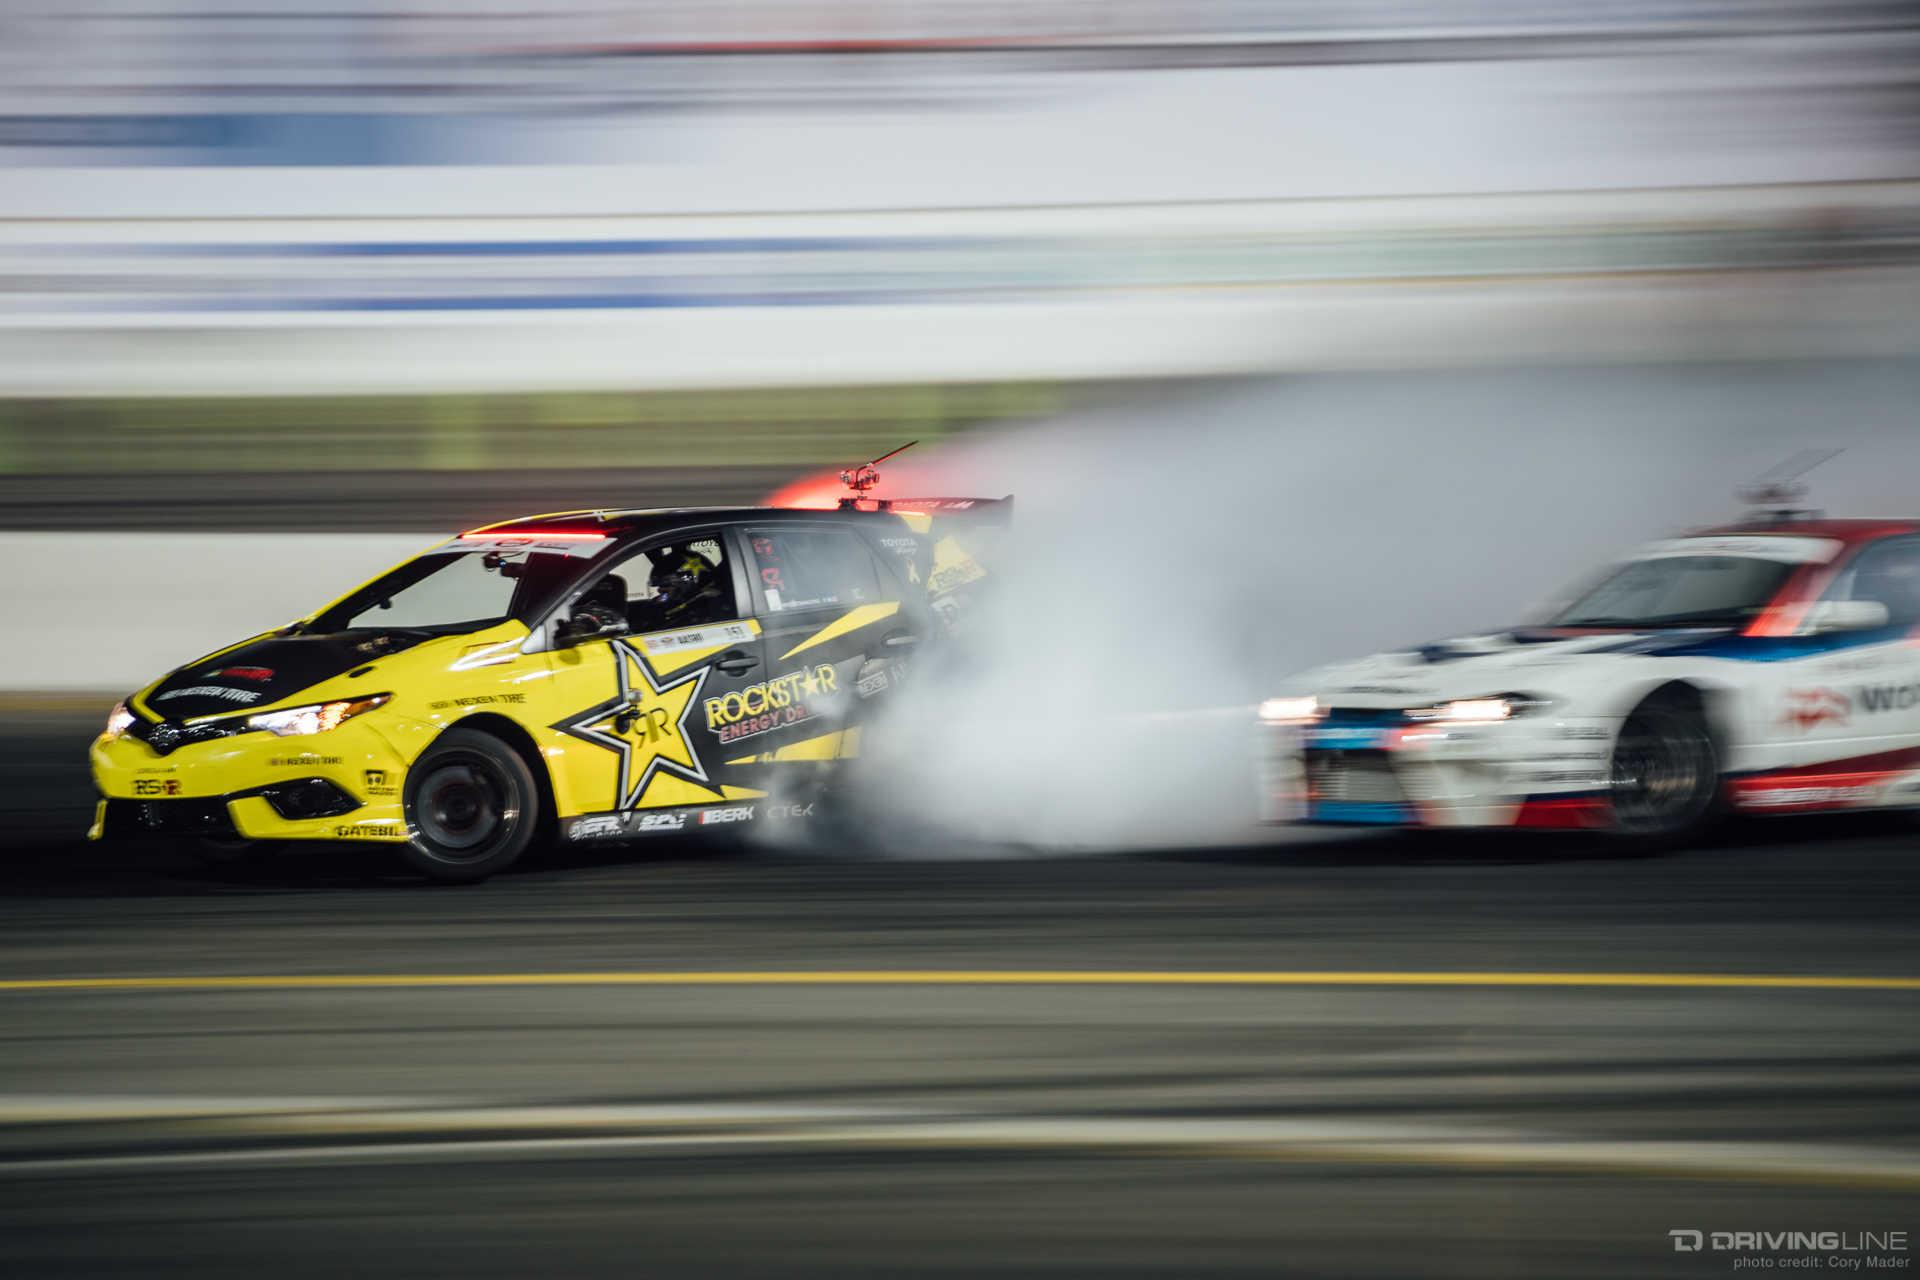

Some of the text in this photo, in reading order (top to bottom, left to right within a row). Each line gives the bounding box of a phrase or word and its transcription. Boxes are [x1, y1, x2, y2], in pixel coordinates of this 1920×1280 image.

[880, 539, 917, 547] TOYOTA
[220, 687, 262, 703] TIRE
[454, 695, 498, 707] NEXEN
[721, 708, 780, 741] ENERGY
[711, 806, 754, 823] BERK
[767, 803, 815, 819] CTEK
